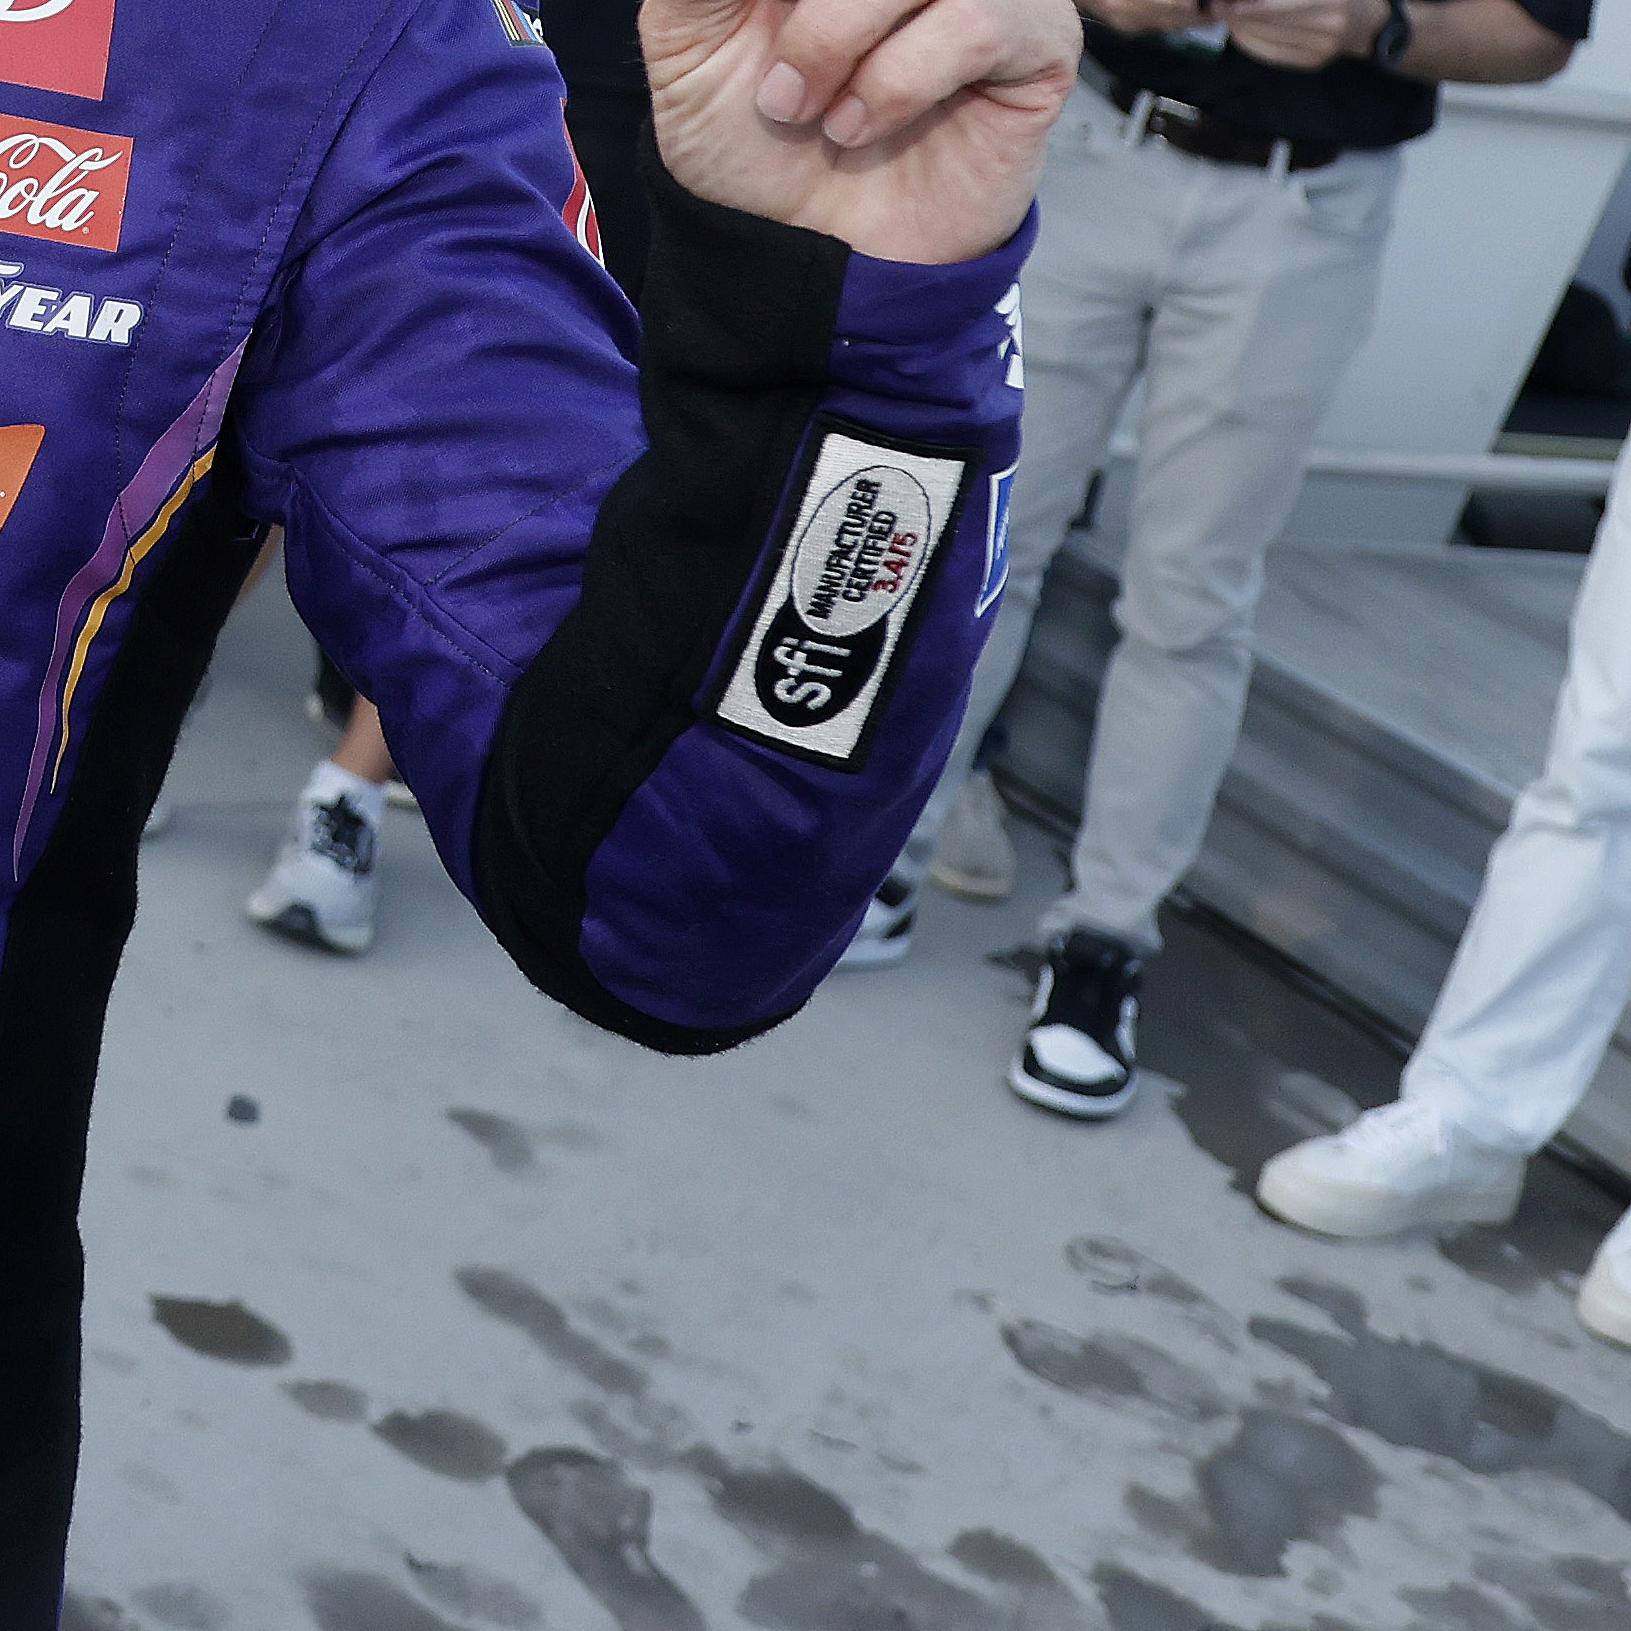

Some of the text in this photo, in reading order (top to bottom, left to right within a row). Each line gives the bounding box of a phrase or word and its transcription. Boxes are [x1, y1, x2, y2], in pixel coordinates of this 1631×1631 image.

[806, 478, 881, 620] MANUFACTURER
[843, 510, 897, 604] CERTIFIED
[774, 636, 853, 711] sfi
